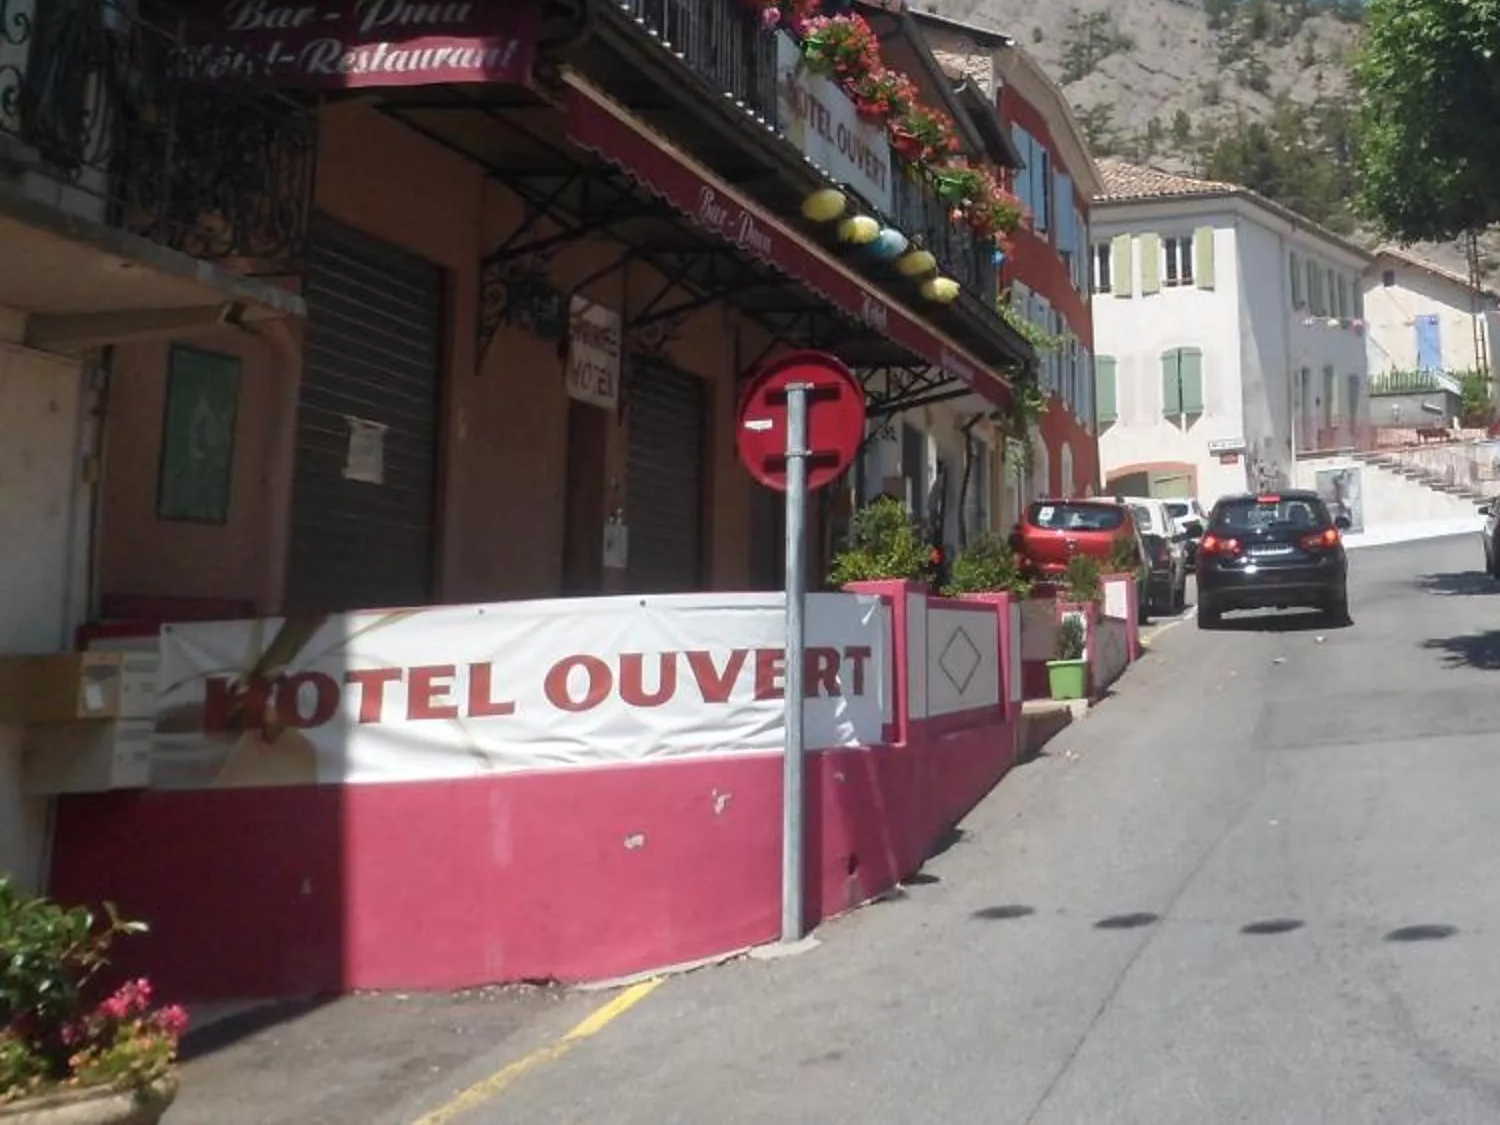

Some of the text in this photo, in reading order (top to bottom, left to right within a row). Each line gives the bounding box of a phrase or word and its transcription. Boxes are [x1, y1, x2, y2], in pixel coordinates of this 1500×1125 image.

[837, 121, 887, 193] OUVERT
[204, 645, 872, 736] HOTEL OUVERT
